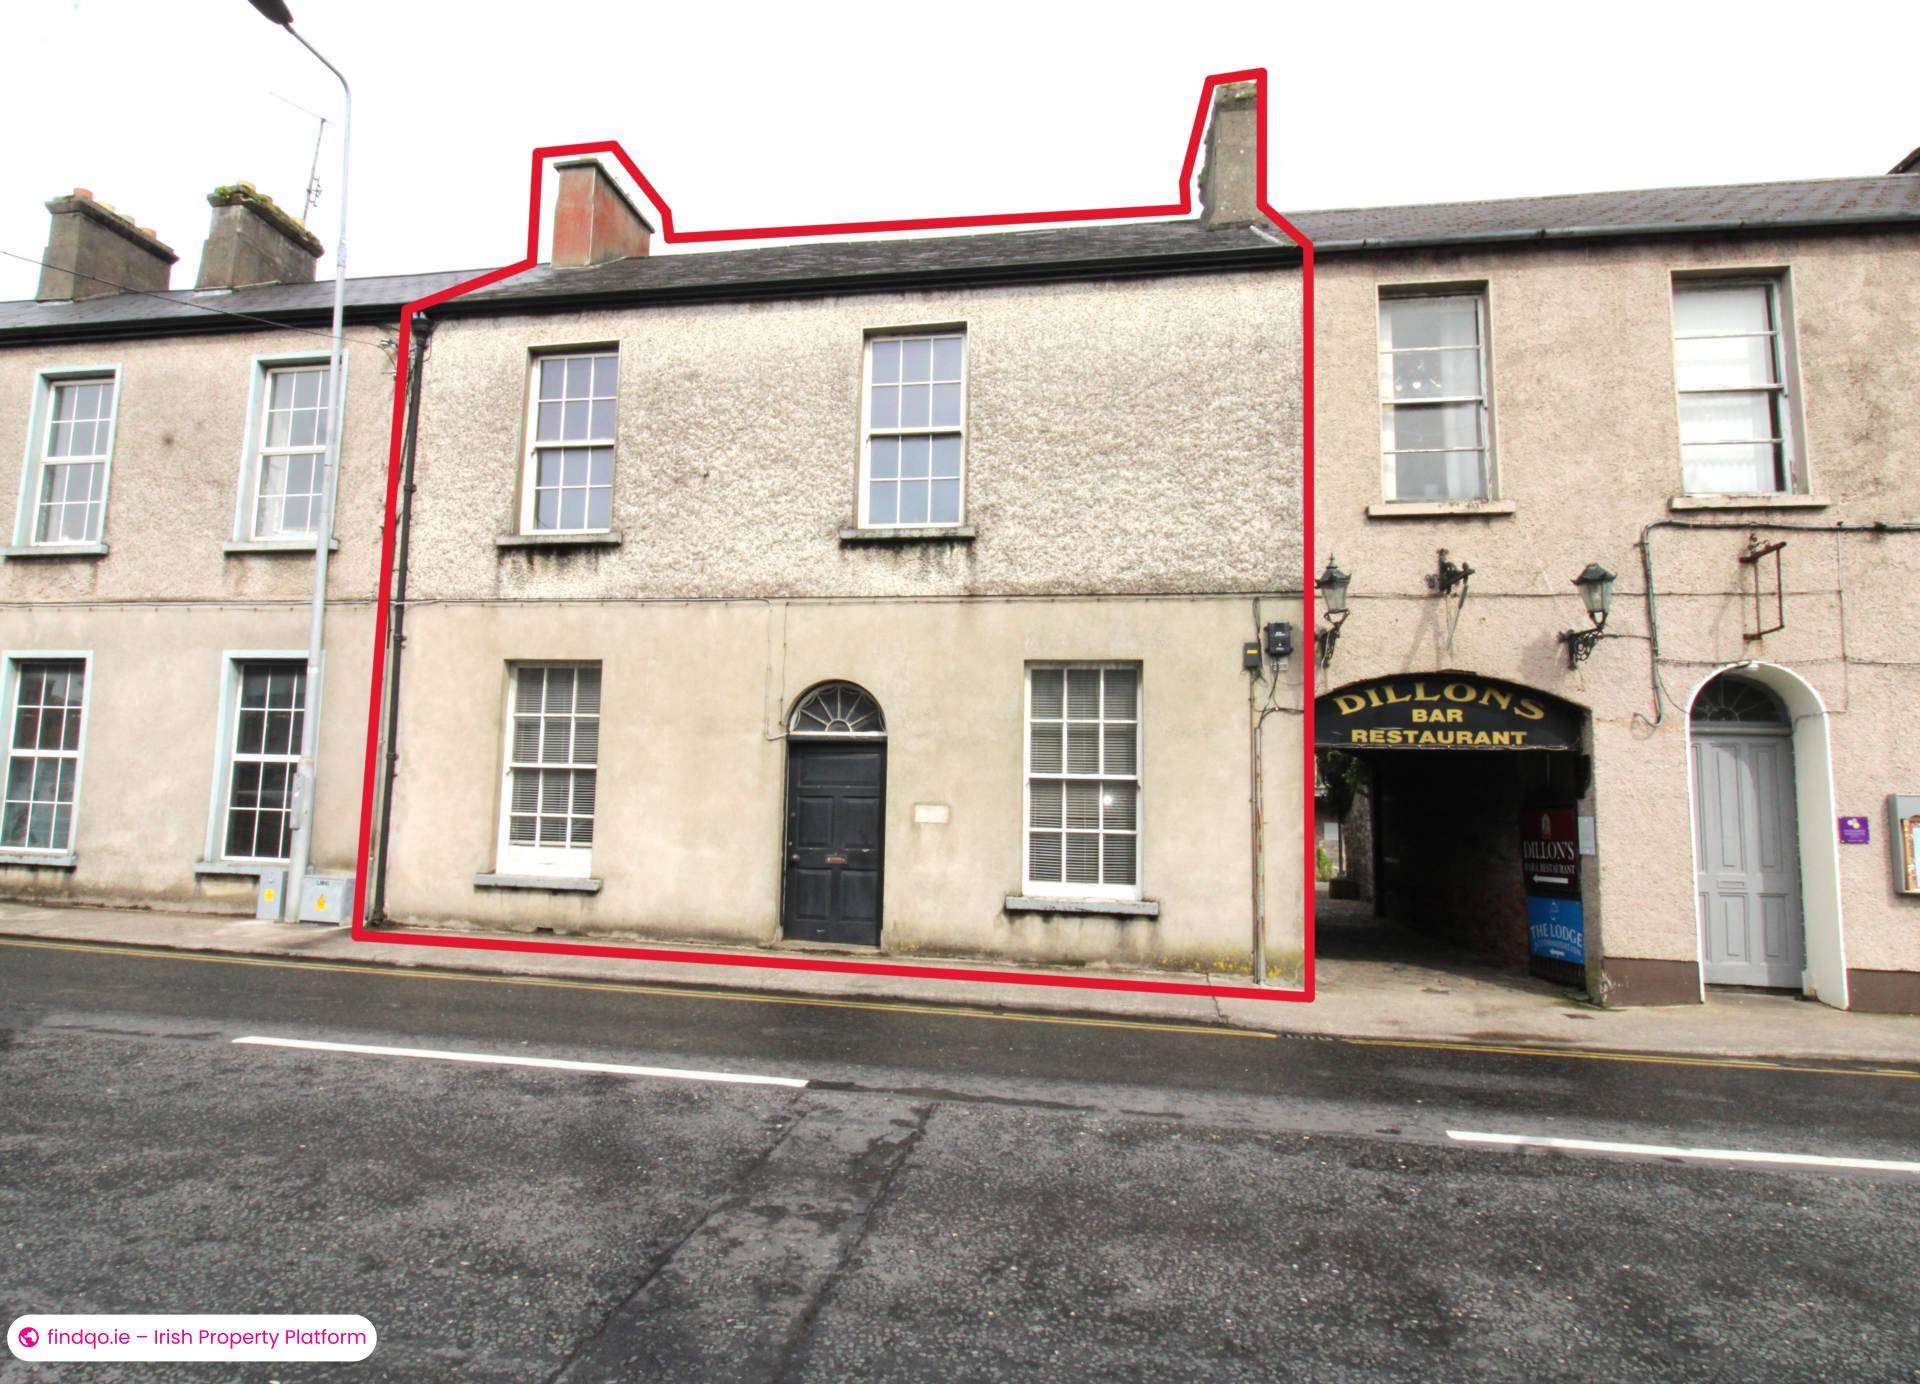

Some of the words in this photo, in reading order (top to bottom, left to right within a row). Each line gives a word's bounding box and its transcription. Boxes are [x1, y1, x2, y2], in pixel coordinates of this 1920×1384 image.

[1333, 682, 1545, 720] DILLONS
[1412, 708, 1463, 723] BAR
[1351, 729, 1527, 745] RESTAURANT
[1523, 840, 1575, 860] DILLON'S
[1530, 922, 1549, 939] THE
[1549, 923, 1583, 949] LODGE
